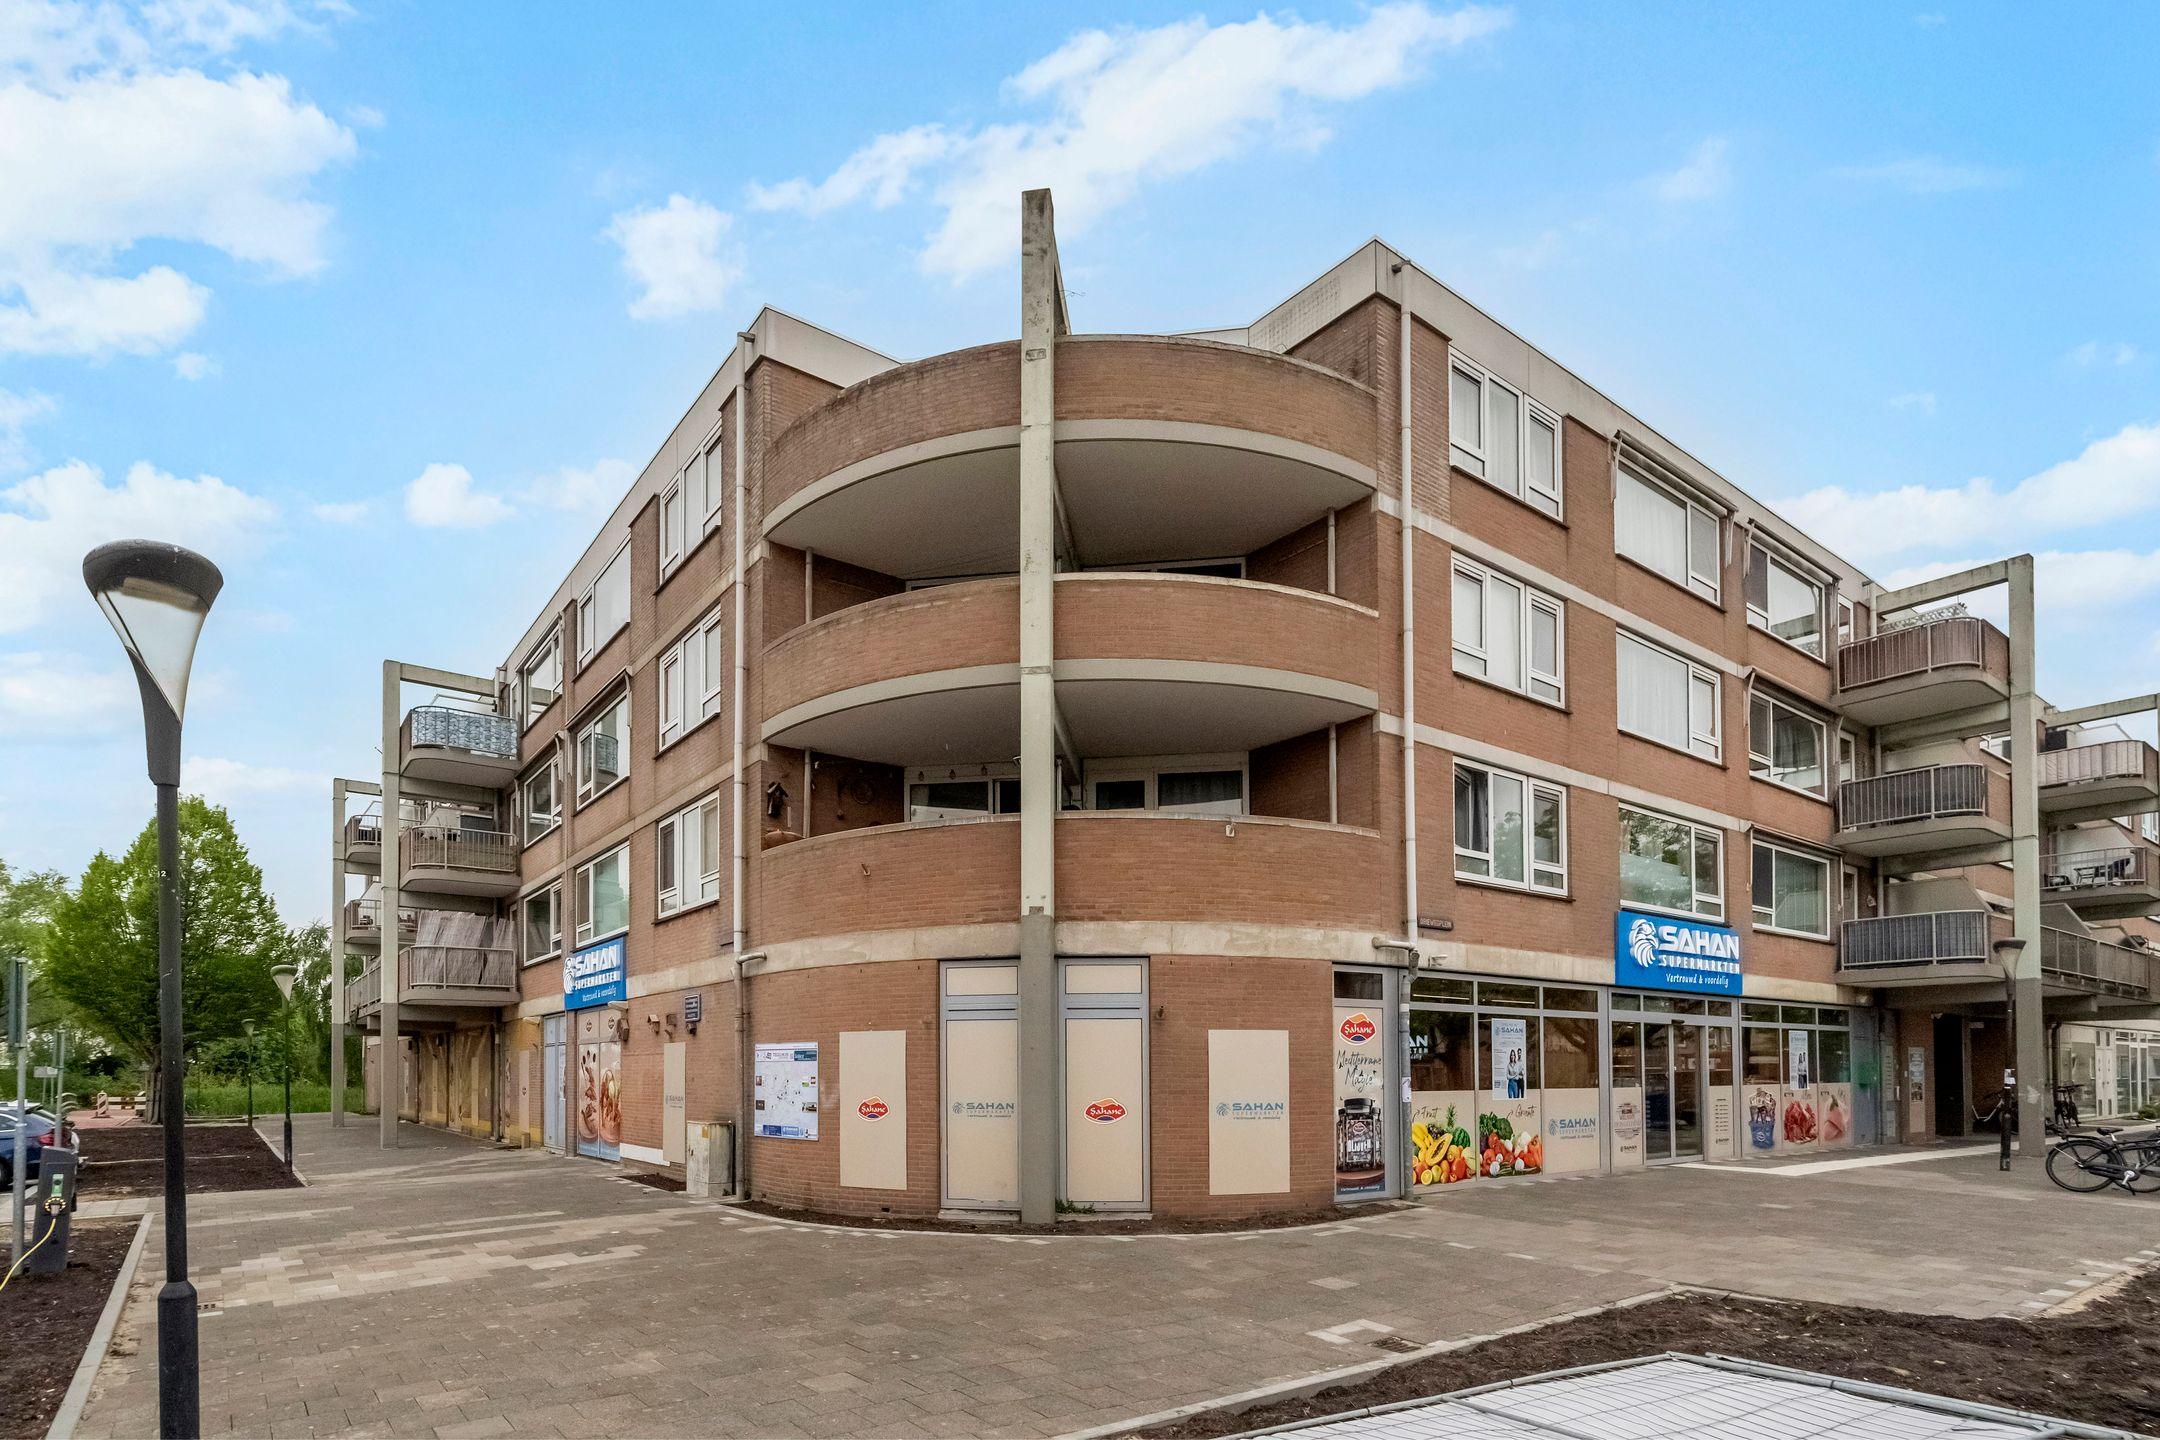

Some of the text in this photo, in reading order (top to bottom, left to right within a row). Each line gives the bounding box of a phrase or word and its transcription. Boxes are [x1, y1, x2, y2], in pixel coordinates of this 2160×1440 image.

[1658, 926, 1740, 960] SAHAN
[575, 945, 620, 978] SAHAN
[1658, 955, 1740, 975] SUPERMARKTEN
[1665, 973, 1729, 988] Vertrouwd & voordelig
[1344, 1024, 1374, 1036] Şahane
[1501, 1026, 1524, 1034] SAHAN
[966, 1102, 1015, 1110] SAHAN
[1089, 1106, 1123, 1116] Şahane
[1232, 1102, 1284, 1111] SAHAN
[1421, 1106, 1440, 1119] Fruit
[1559, 1118, 1596, 1129] SAHAN
